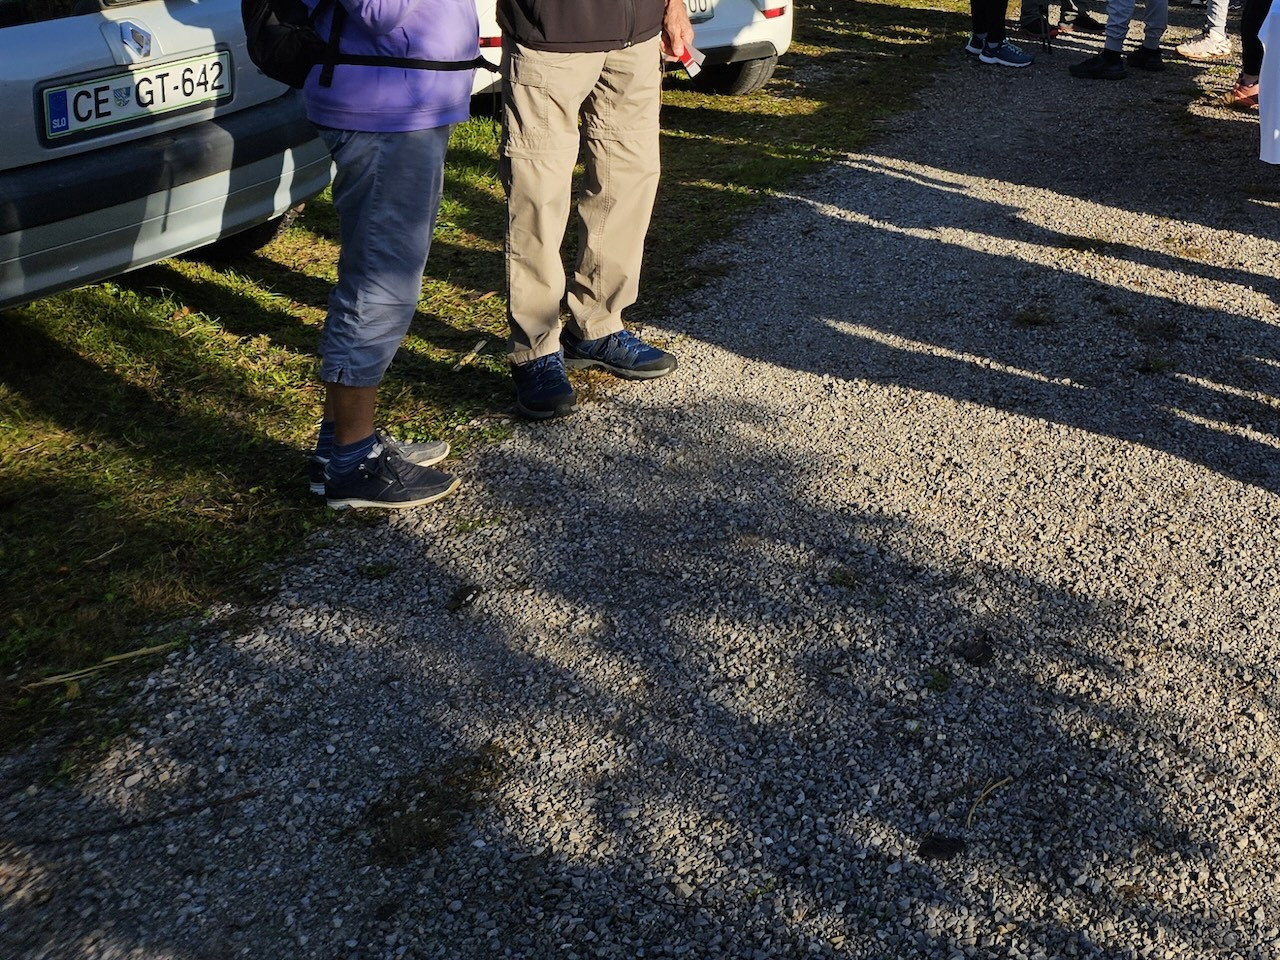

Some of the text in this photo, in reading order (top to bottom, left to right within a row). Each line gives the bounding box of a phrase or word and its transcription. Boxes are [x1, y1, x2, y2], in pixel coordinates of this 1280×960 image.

[73, 61, 224, 122] CE GT-642
[52, 117, 66, 129] SLO
